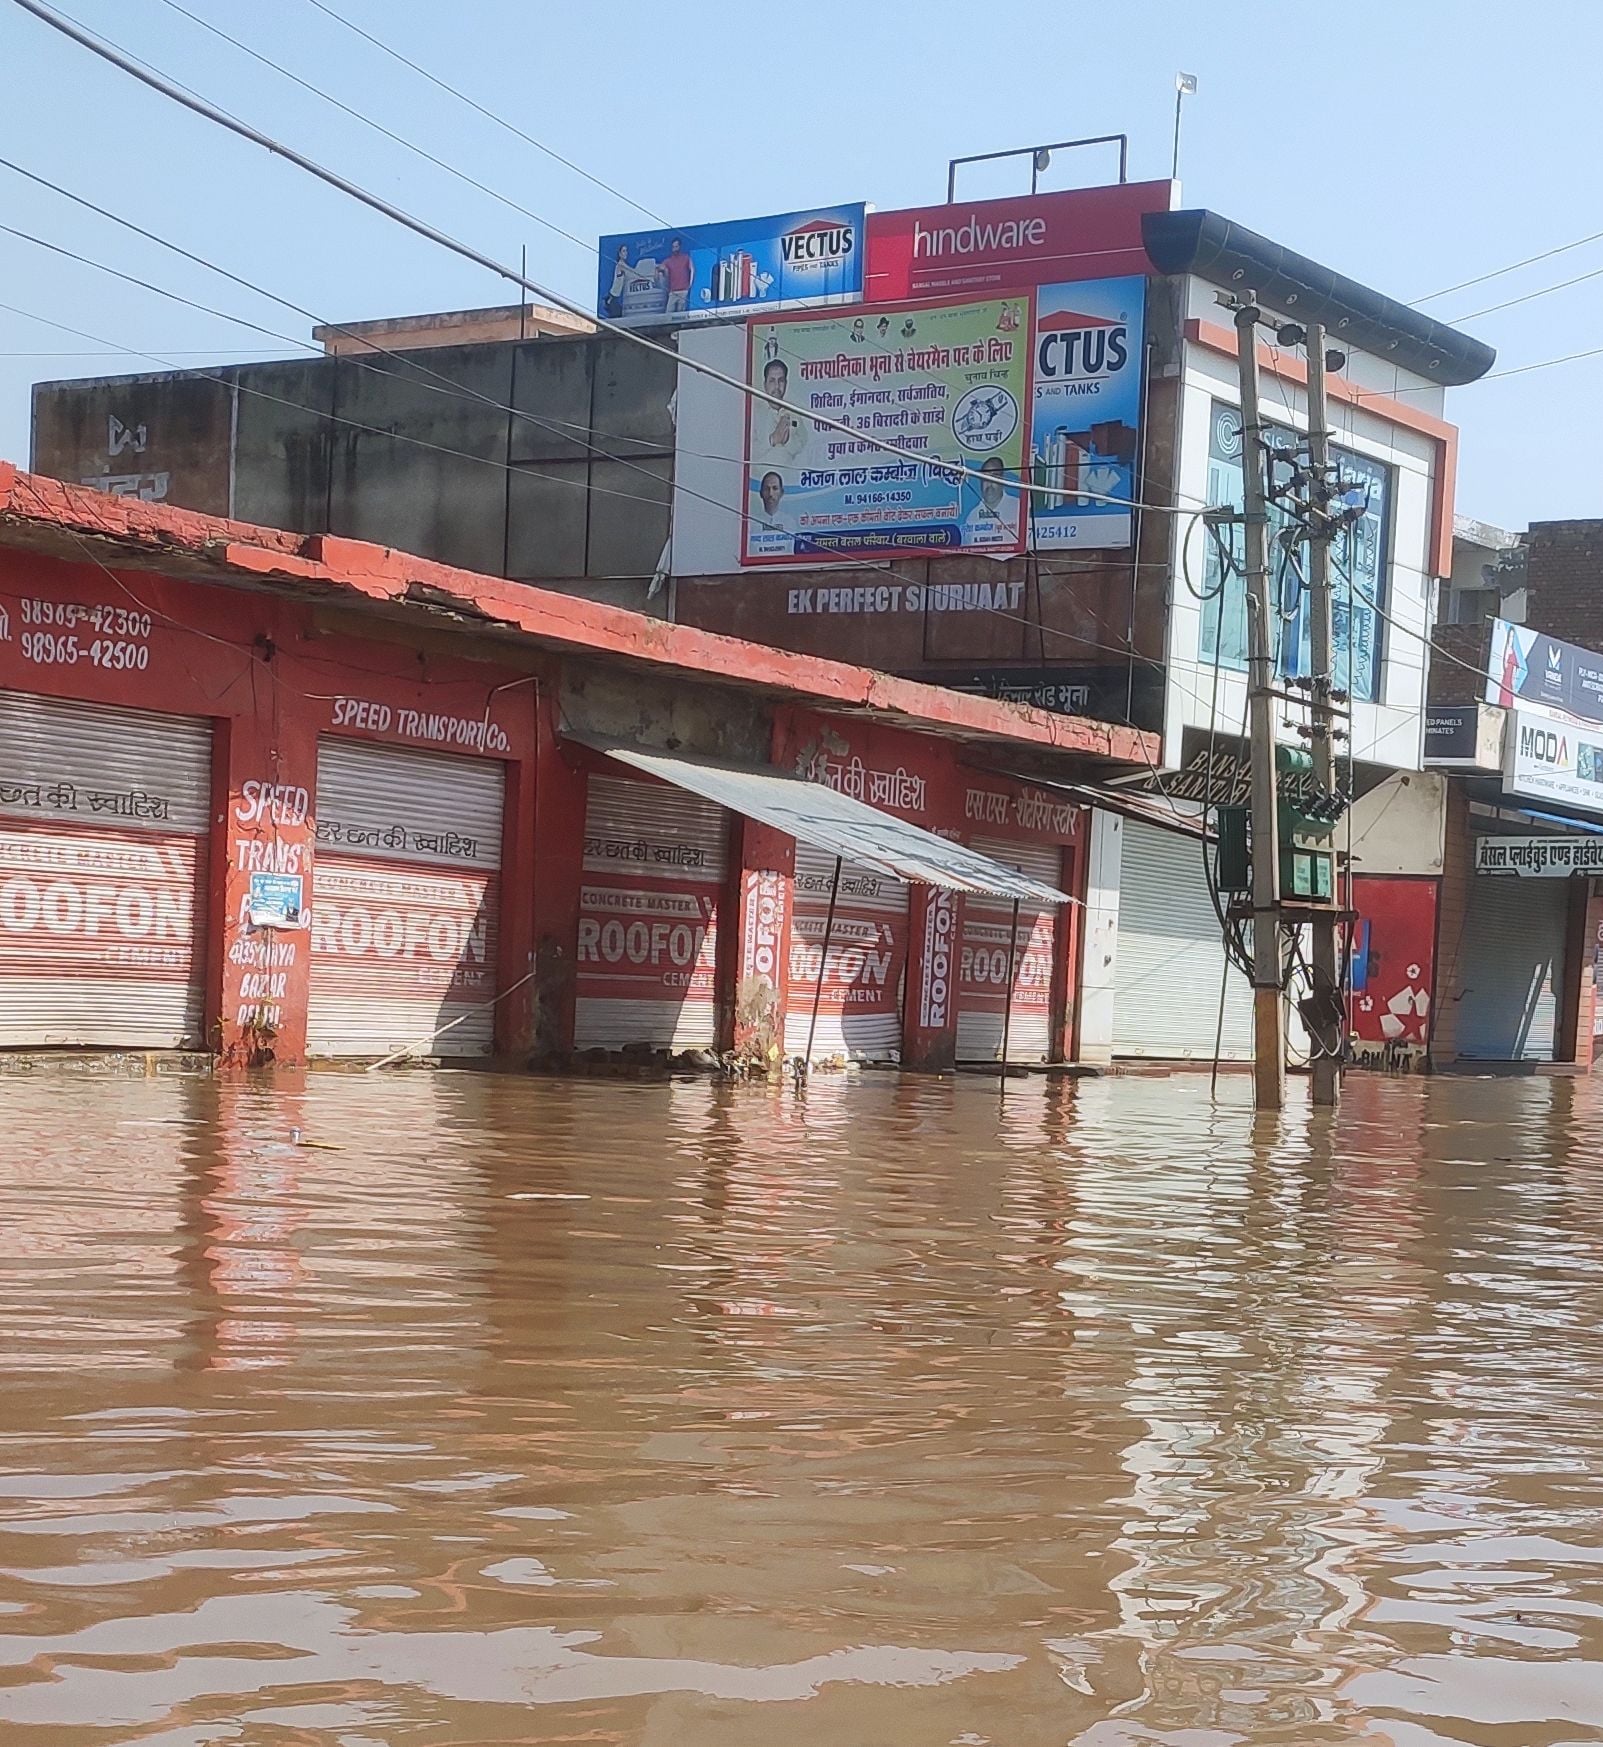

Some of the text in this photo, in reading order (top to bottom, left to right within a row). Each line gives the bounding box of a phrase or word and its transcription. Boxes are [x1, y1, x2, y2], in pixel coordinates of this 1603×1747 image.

[781, 228, 853, 262] VECTUS
[914, 215, 1046, 258] hindware
[800, 338, 1013, 382] नगरपालिका भूना से चेयरमैन पद के लिए
[1045, 386, 1061, 396] AND
[1064, 382, 1100, 397] TANKS
[856, 415, 870, 429] 36
[801, 470, 836, 488] भजन
[839, 468, 869, 487] लाल
[788, 582, 1024, 614] EK PERFECT SHURUAAT
[21, 598, 151, 638] 98965-42300
[21, 632, 149, 670] 98965-42500
[1059, 684, 1089, 711] भूना
[332, 699, 511, 752] SPEED TRANSPORT Co.
[1519, 725, 1569, 768] MODA
[47, 781, 78, 811] की
[844, 756, 926, 812] की ख्वाहिश
[235, 780, 309, 828] SPEED
[315, 819, 478, 858] हर छत की ख्वाहिश
[605, 840, 631, 860] छत
[632, 840, 649, 862] की
[1509, 840, 1548, 874] प्लाईवुड
[1549, 845, 1571, 867] एण्ड
[582, 892, 691, 912] CONCRETE MASTER
[311, 901, 487, 962] ROOFON
[577, 917, 716, 969] ROOFON
[930, 885, 952, 1028] ROOFON
[663, 971, 715, 987] CEMENT
